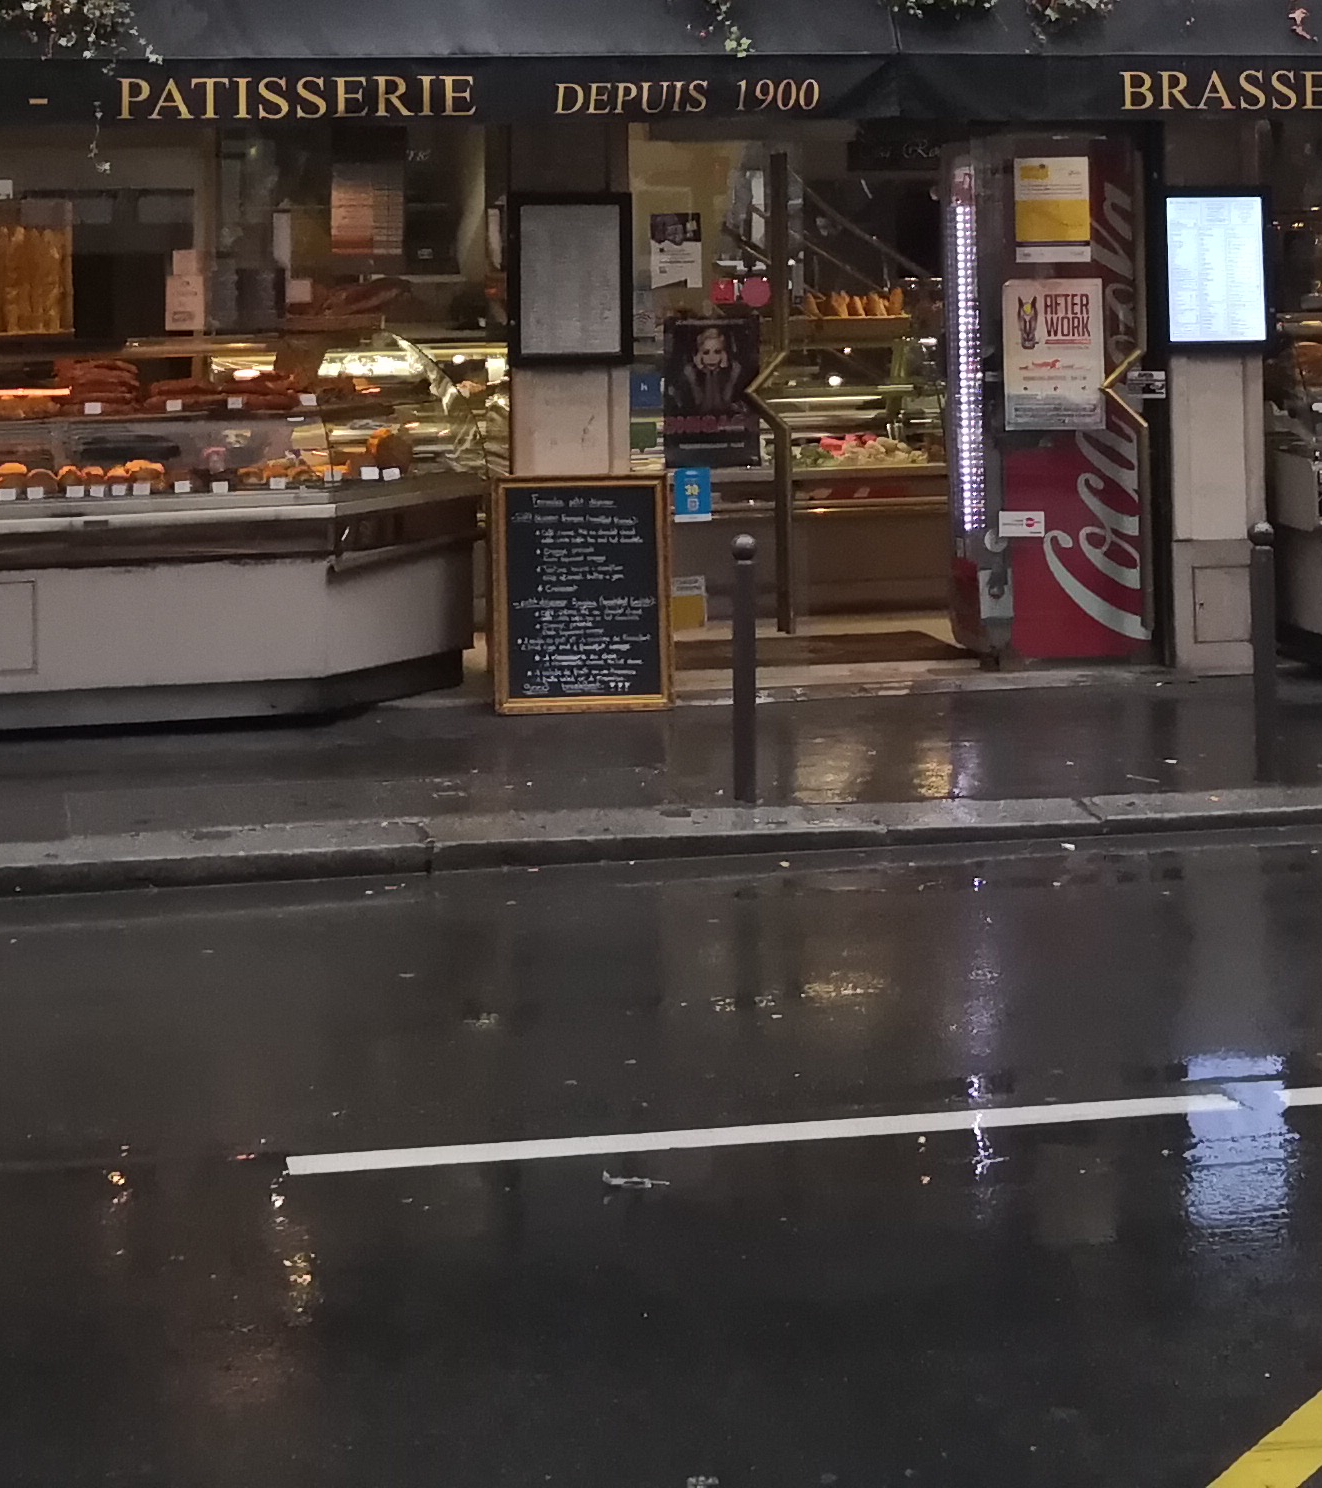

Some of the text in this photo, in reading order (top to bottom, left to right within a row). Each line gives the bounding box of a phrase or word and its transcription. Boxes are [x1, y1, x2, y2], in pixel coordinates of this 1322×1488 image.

[116, 75, 477, 120] PATISSERIE
[554, 78, 820, 115] DEPUIS 1900
[1043, 293, 1090, 315] AFTER
[1044, 315, 1091, 338] WORK
